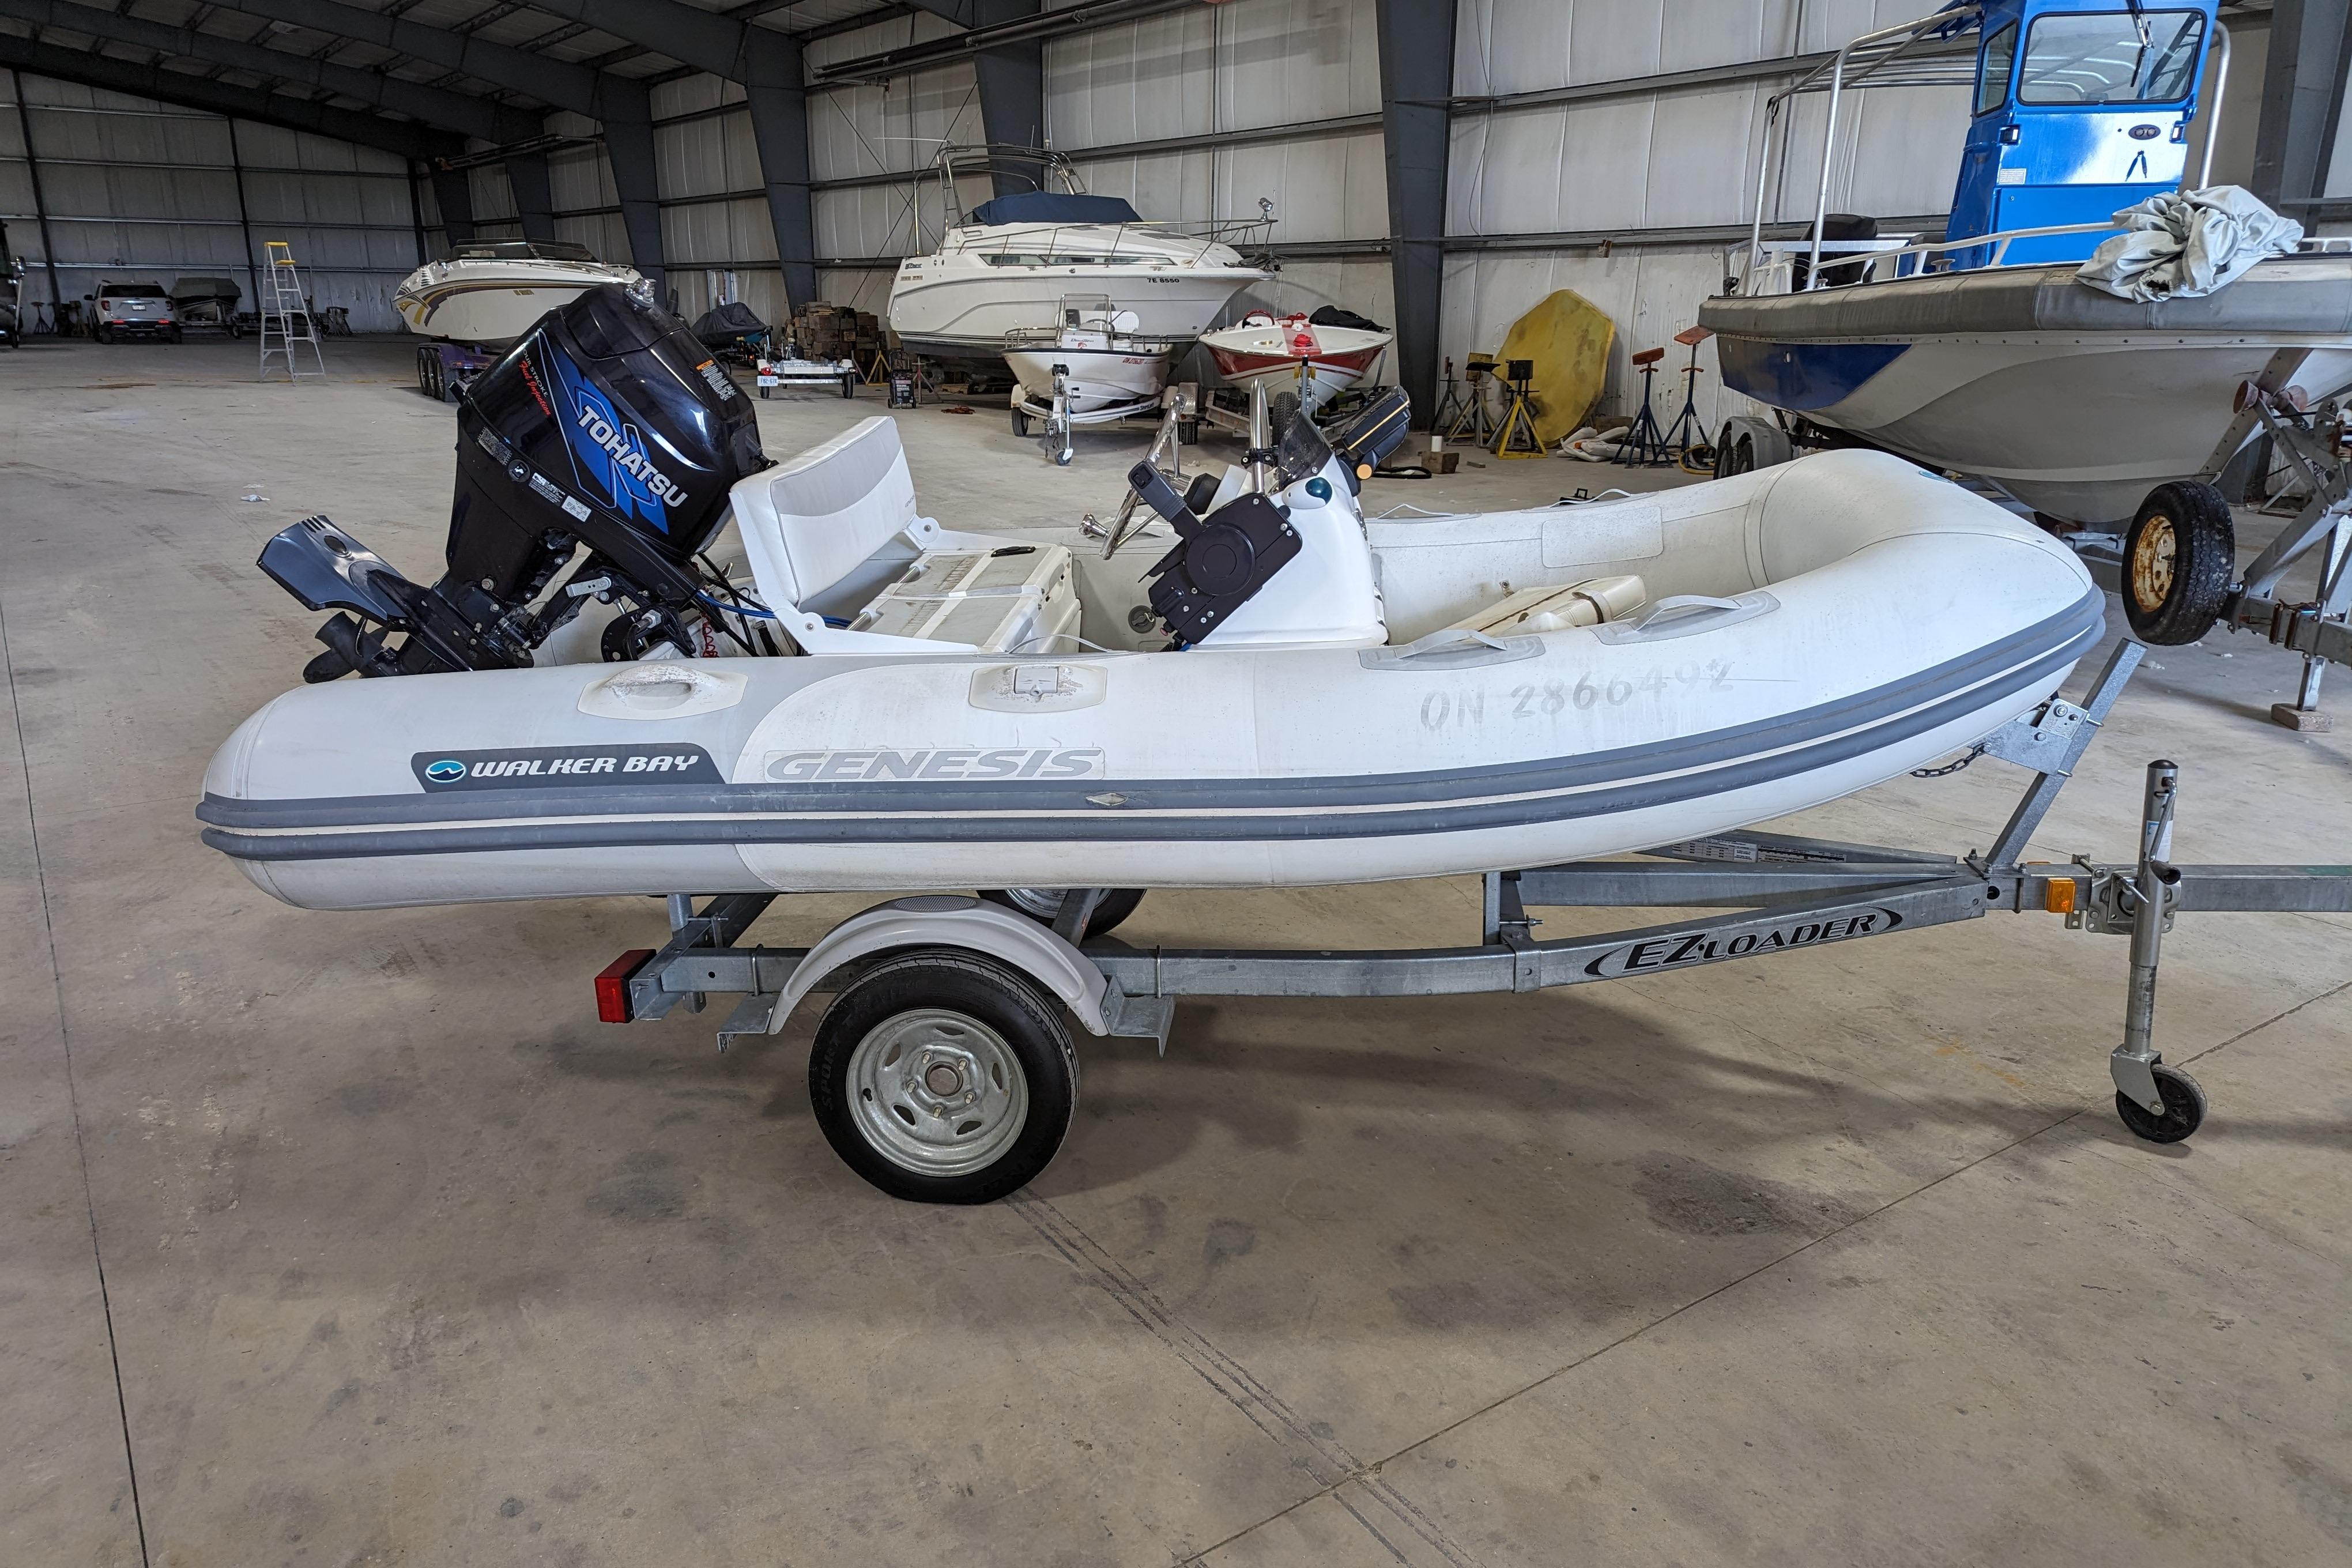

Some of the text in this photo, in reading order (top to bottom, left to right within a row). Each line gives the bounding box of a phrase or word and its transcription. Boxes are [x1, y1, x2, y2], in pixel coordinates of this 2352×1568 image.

[530, 367, 548, 398] STROKE
[578, 405, 688, 507] TOHATSU
[470, 755, 700, 778] WALKER BAY
[766, 749, 1103, 780] GENESIS
